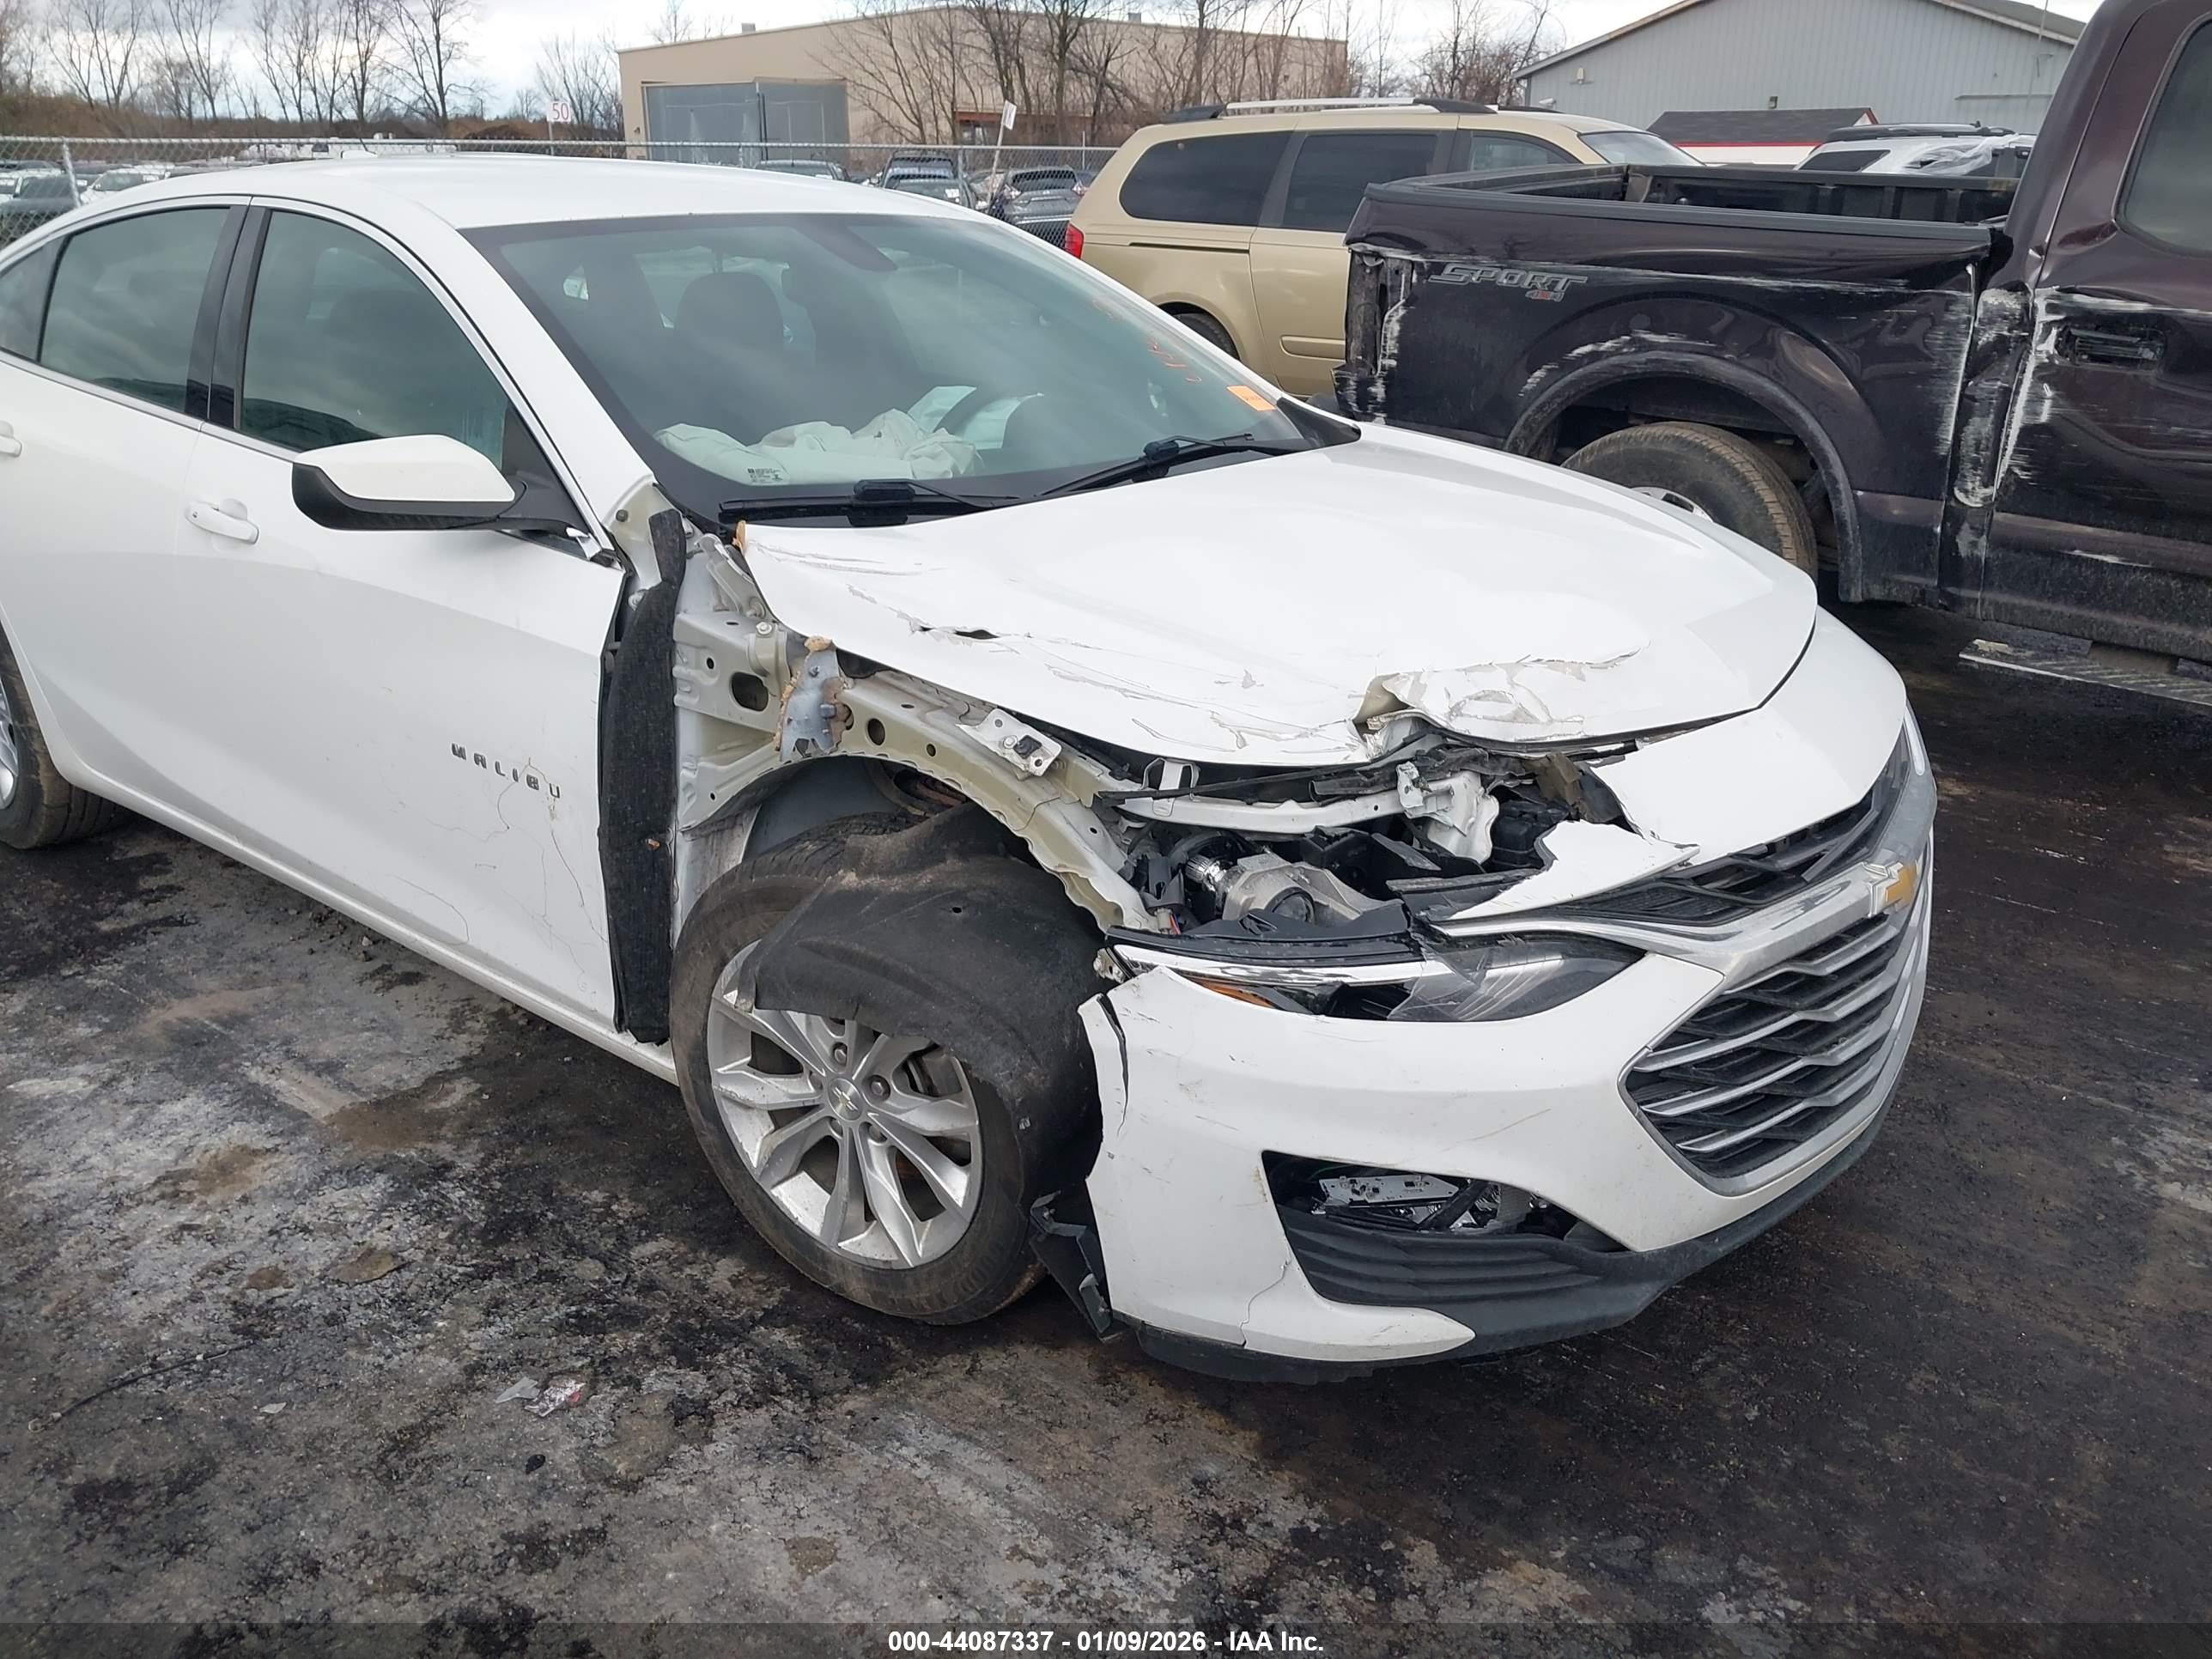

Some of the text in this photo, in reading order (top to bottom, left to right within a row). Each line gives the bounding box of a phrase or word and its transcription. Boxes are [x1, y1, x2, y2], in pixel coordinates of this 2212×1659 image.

[552, 102, 569, 120] 50
[1428, 263, 1588, 292] SPORT
[451, 742, 561, 799] MALIBU
